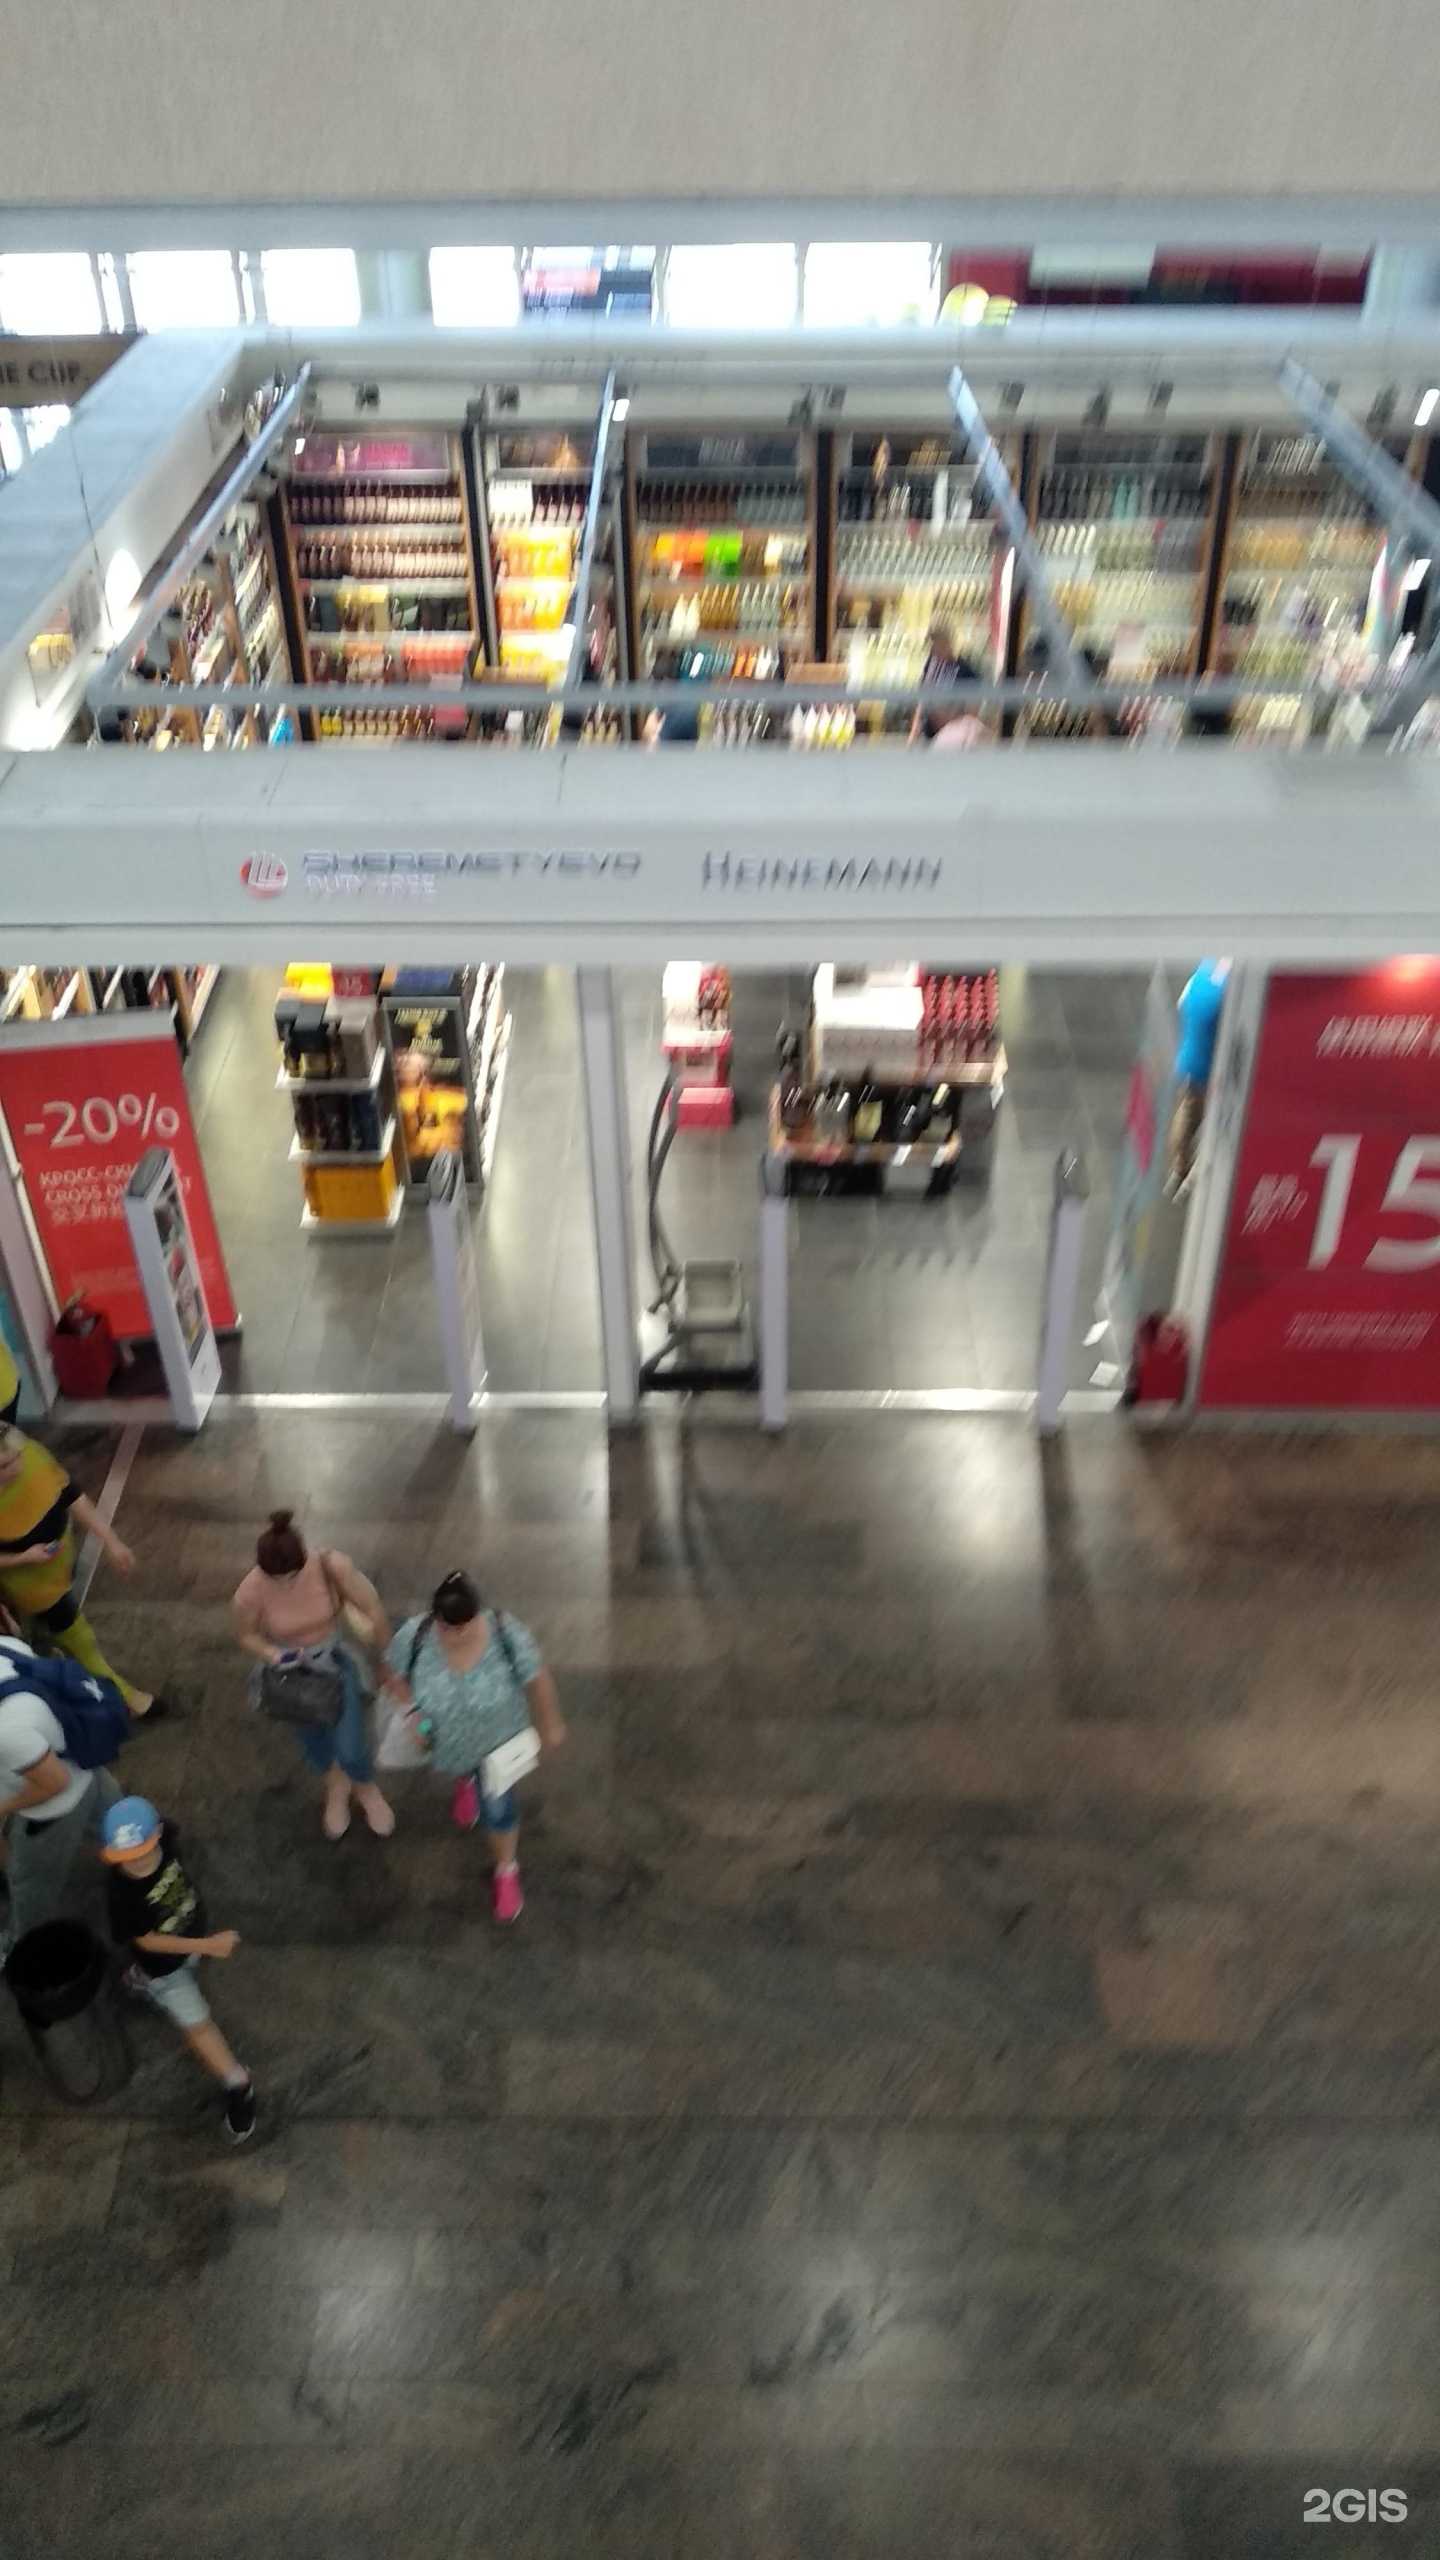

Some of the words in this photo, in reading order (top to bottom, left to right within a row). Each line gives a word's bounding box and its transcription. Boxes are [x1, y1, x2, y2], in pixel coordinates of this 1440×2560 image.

[303, 850, 641, 876] SHEREMETYEVO
[702, 851, 942, 888] HEINEMANN
[24, 1092, 180, 1148] -20%
